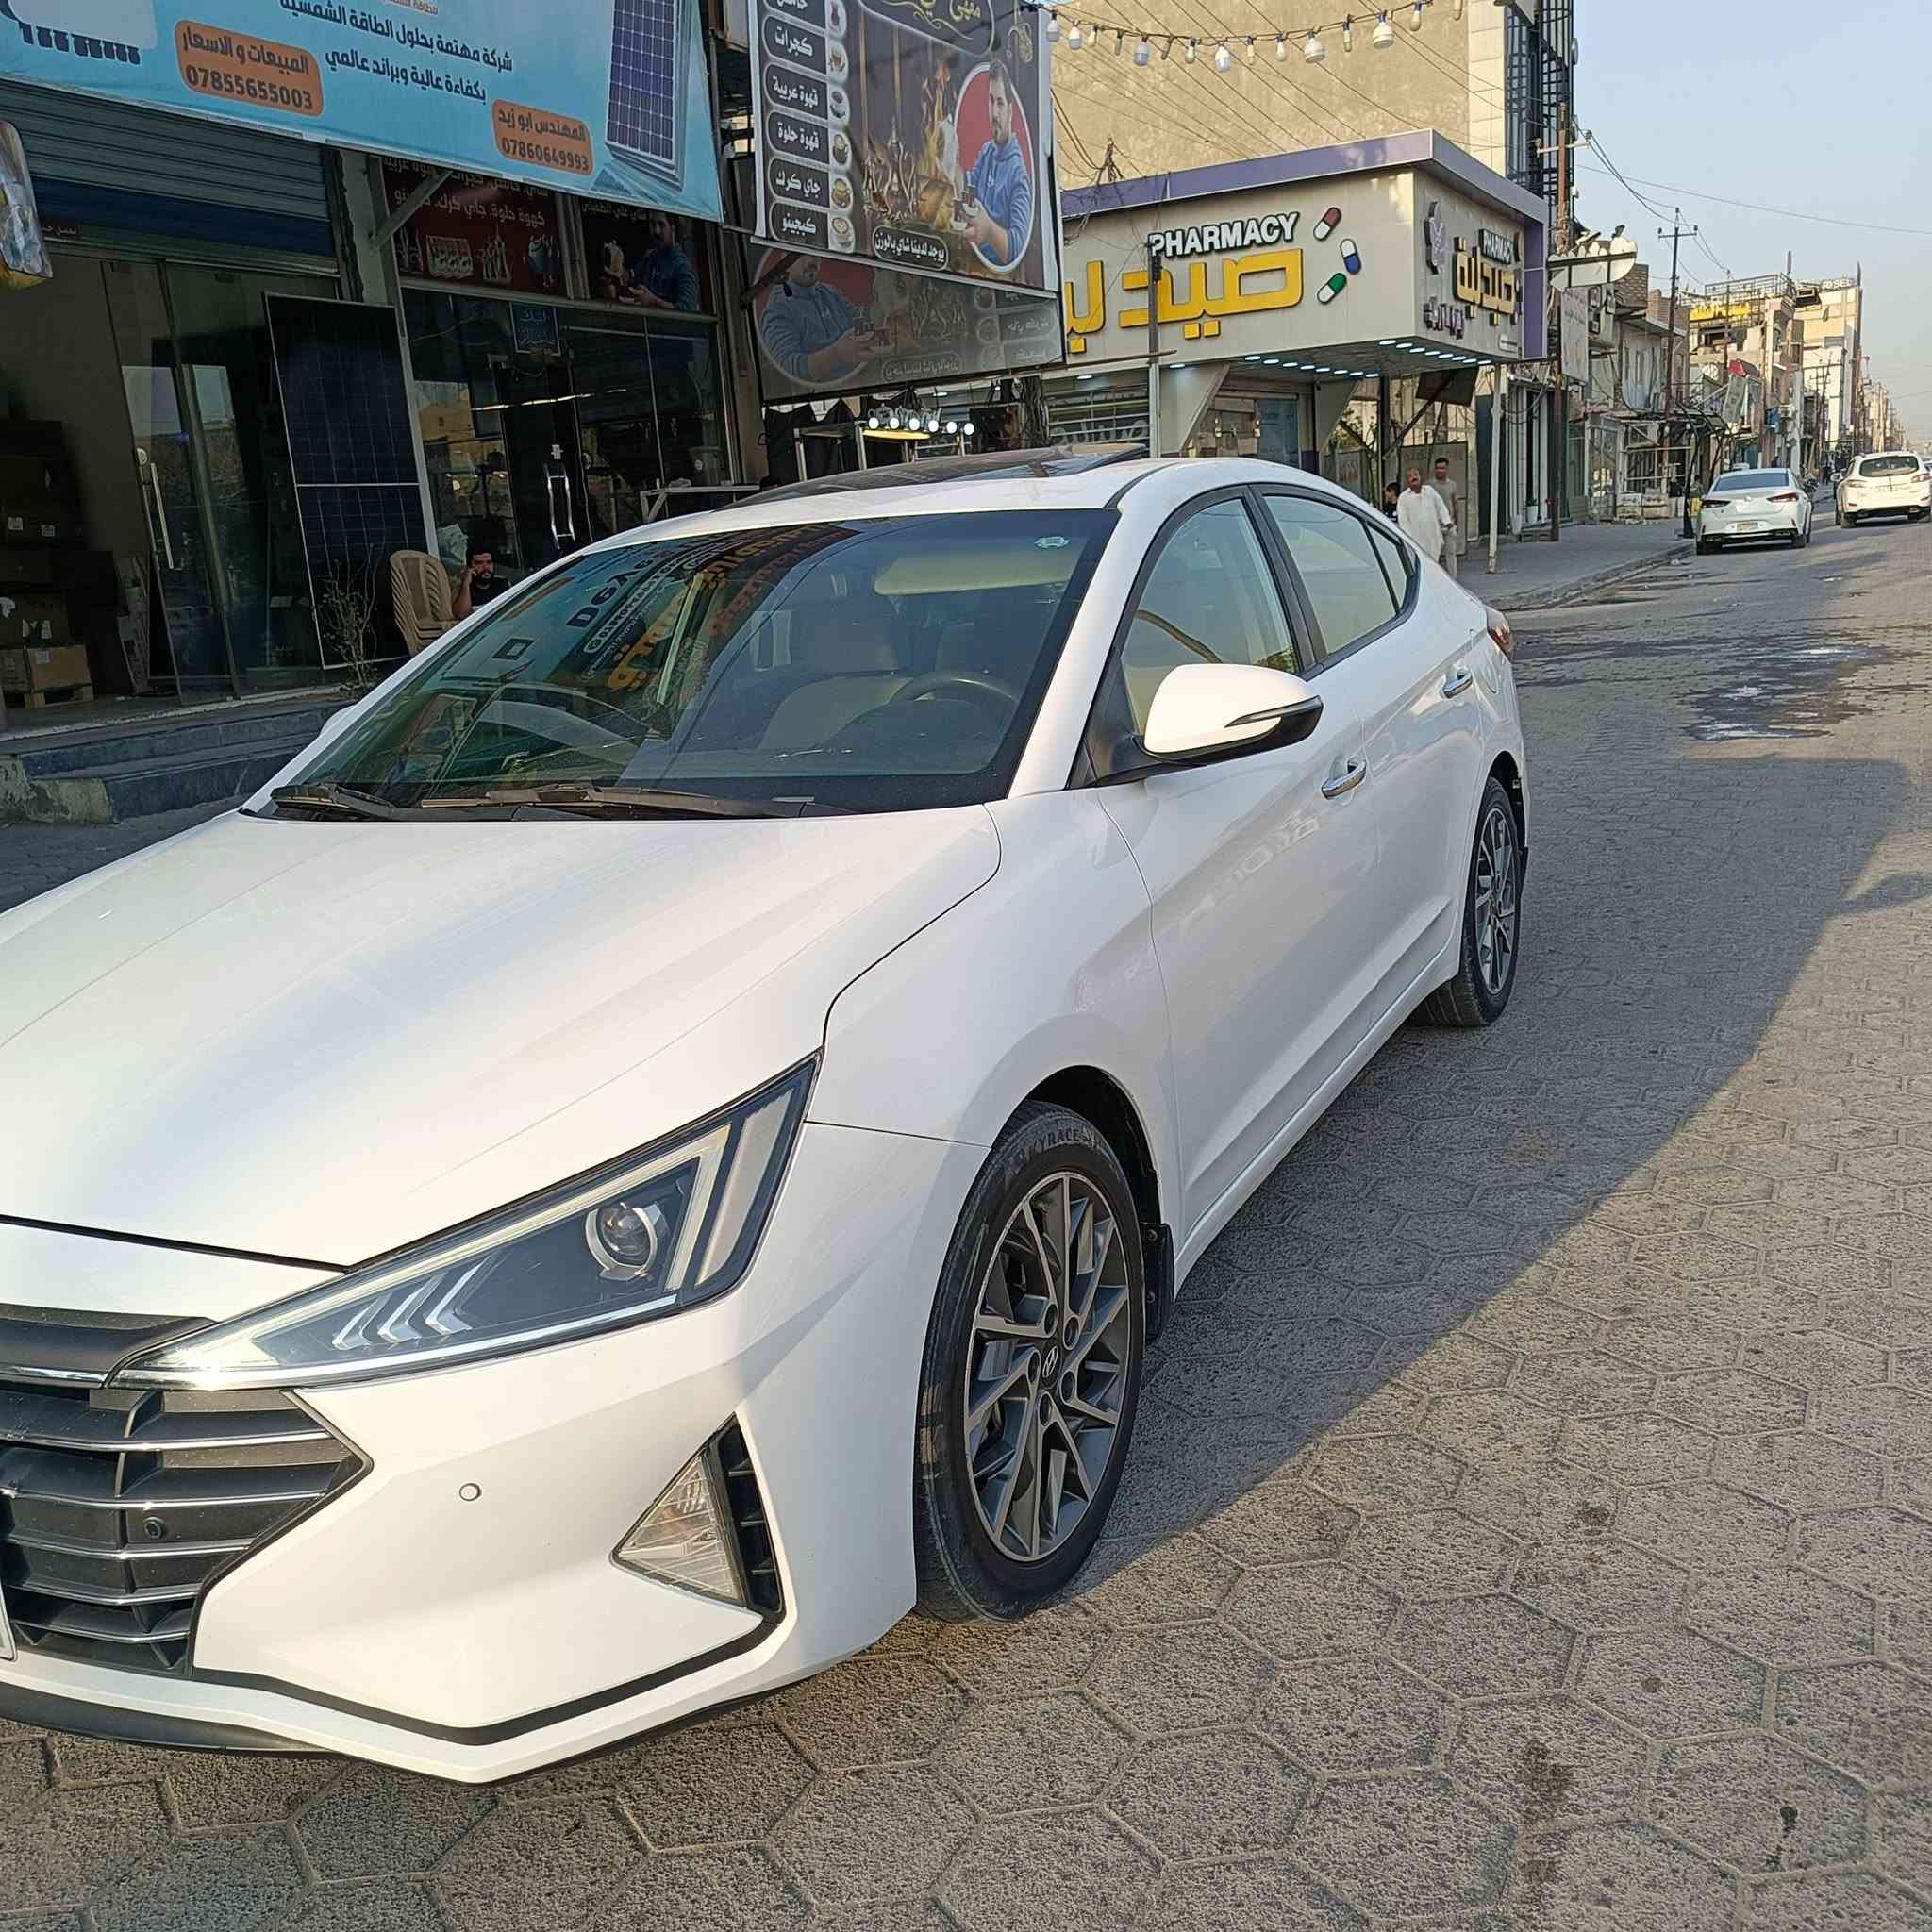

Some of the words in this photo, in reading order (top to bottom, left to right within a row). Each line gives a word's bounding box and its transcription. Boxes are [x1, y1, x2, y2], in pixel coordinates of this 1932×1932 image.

[349, 12, 394, 39] الطاقة
[181, 26, 234, 58] الاسعار
[395, 24, 434, 56] بحلول
[436, 35, 480, 62] مهتمة
[774, 26, 813, 57] كجرات
[236, 45, 246, 65] و
[248, 45, 309, 75] المبيعات
[325, 49, 371, 73] عالمي
[482, 47, 513, 73] شركة
[372, 56, 408, 86] وبراند
[409, 65, 444, 92] عالية
[185, 64, 313, 110] 07855655003
[444, 75, 488, 106] بكفاءة
[772, 76, 799, 101] عربية
[799, 85, 819, 108] قهوة
[498, 108, 515, 129] زيد
[518, 112, 533, 133] ابو
[535, 120, 587, 142] المهندس
[776, 121, 798, 143] حلوة
[799, 127, 820, 152] قهوة
[501, 137, 590, 171] 07860649993
[775, 169, 802, 192] كرك
[803, 177, 822, 198] جاي
[875, 232, 896, 254] بالوزن
[896, 237, 910, 257] شاي
[1150, 211, 1300, 258] PHARMACY
[927, 245, 945, 262] يوجد
[1453, 236, 1515, 326] صيدلية
